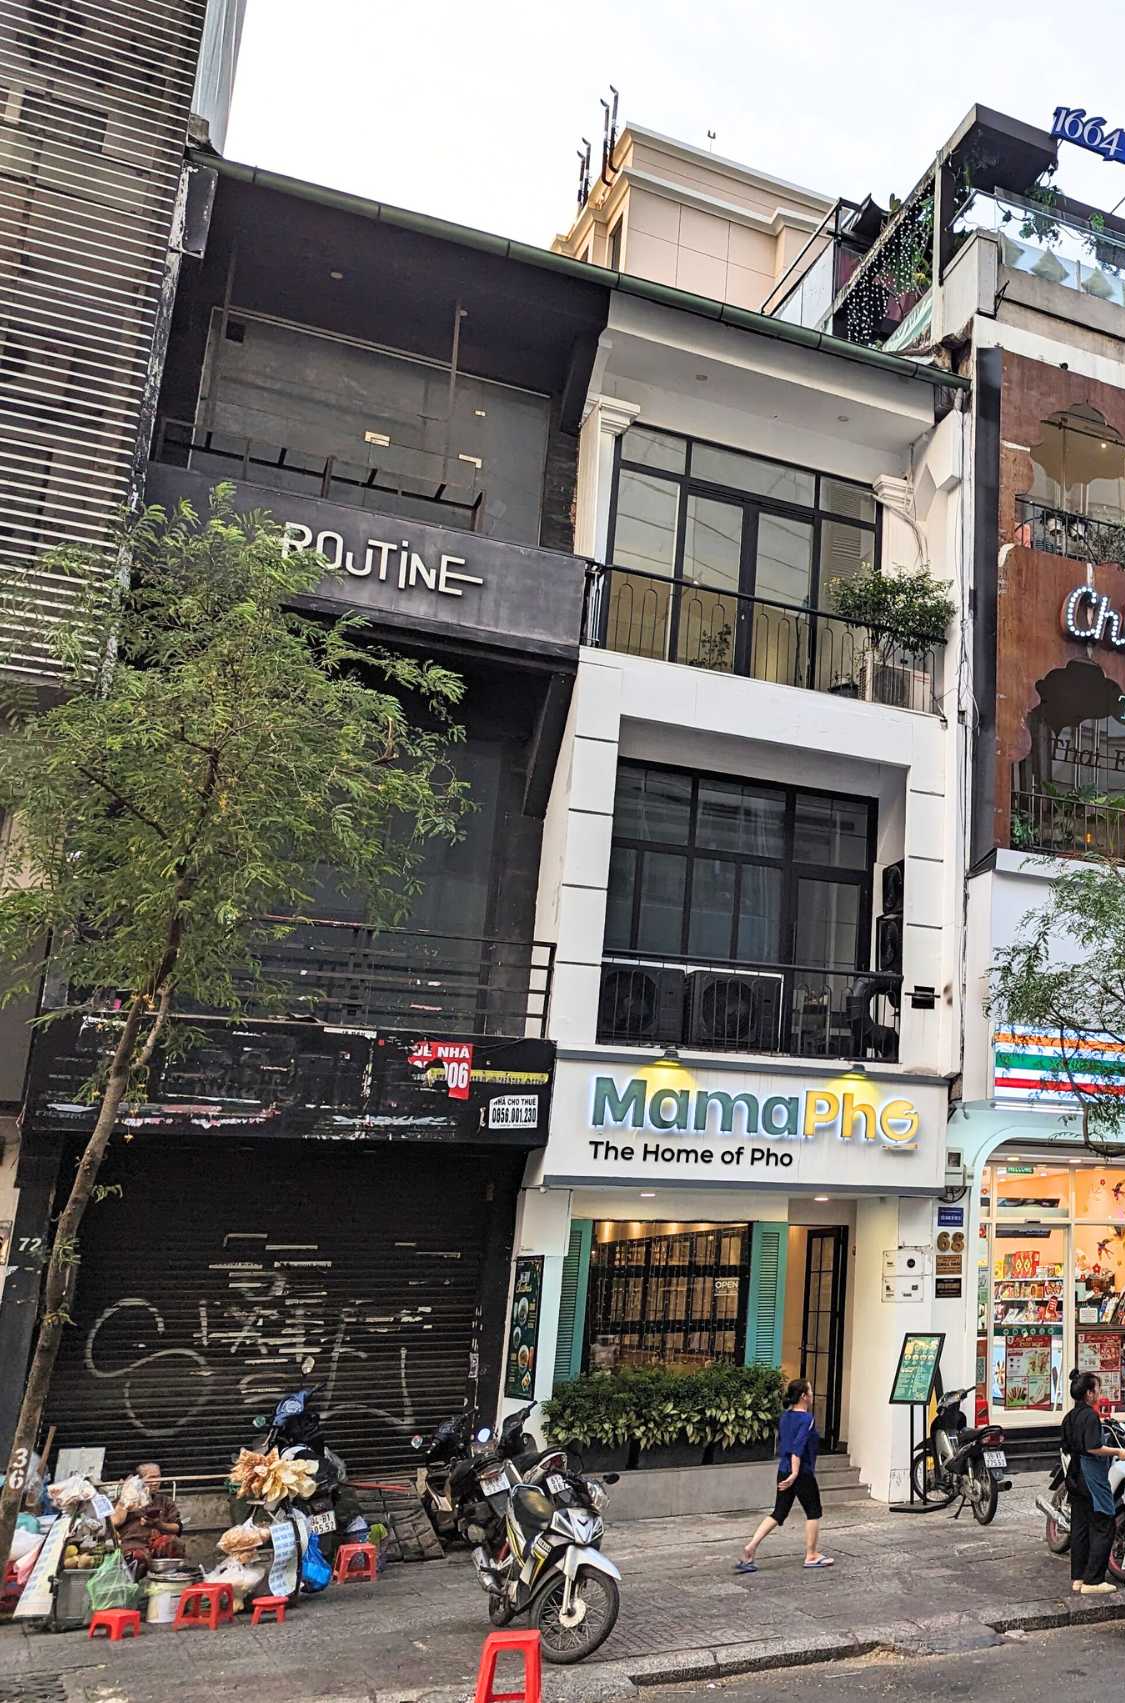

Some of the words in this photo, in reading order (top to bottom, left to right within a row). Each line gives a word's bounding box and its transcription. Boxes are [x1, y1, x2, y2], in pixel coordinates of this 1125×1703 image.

[1051, 107, 1123, 158] 1664
[588, 1140, 635, 1161] The
[642, 1143, 714, 1164] Home
[721, 1146, 744, 1165] of
[750, 1148, 794, 1168] Pho
[18, 1237, 42, 1252] 72
[936, 1231, 965, 1253] 68
[715, 1281, 738, 1289] OPEN
